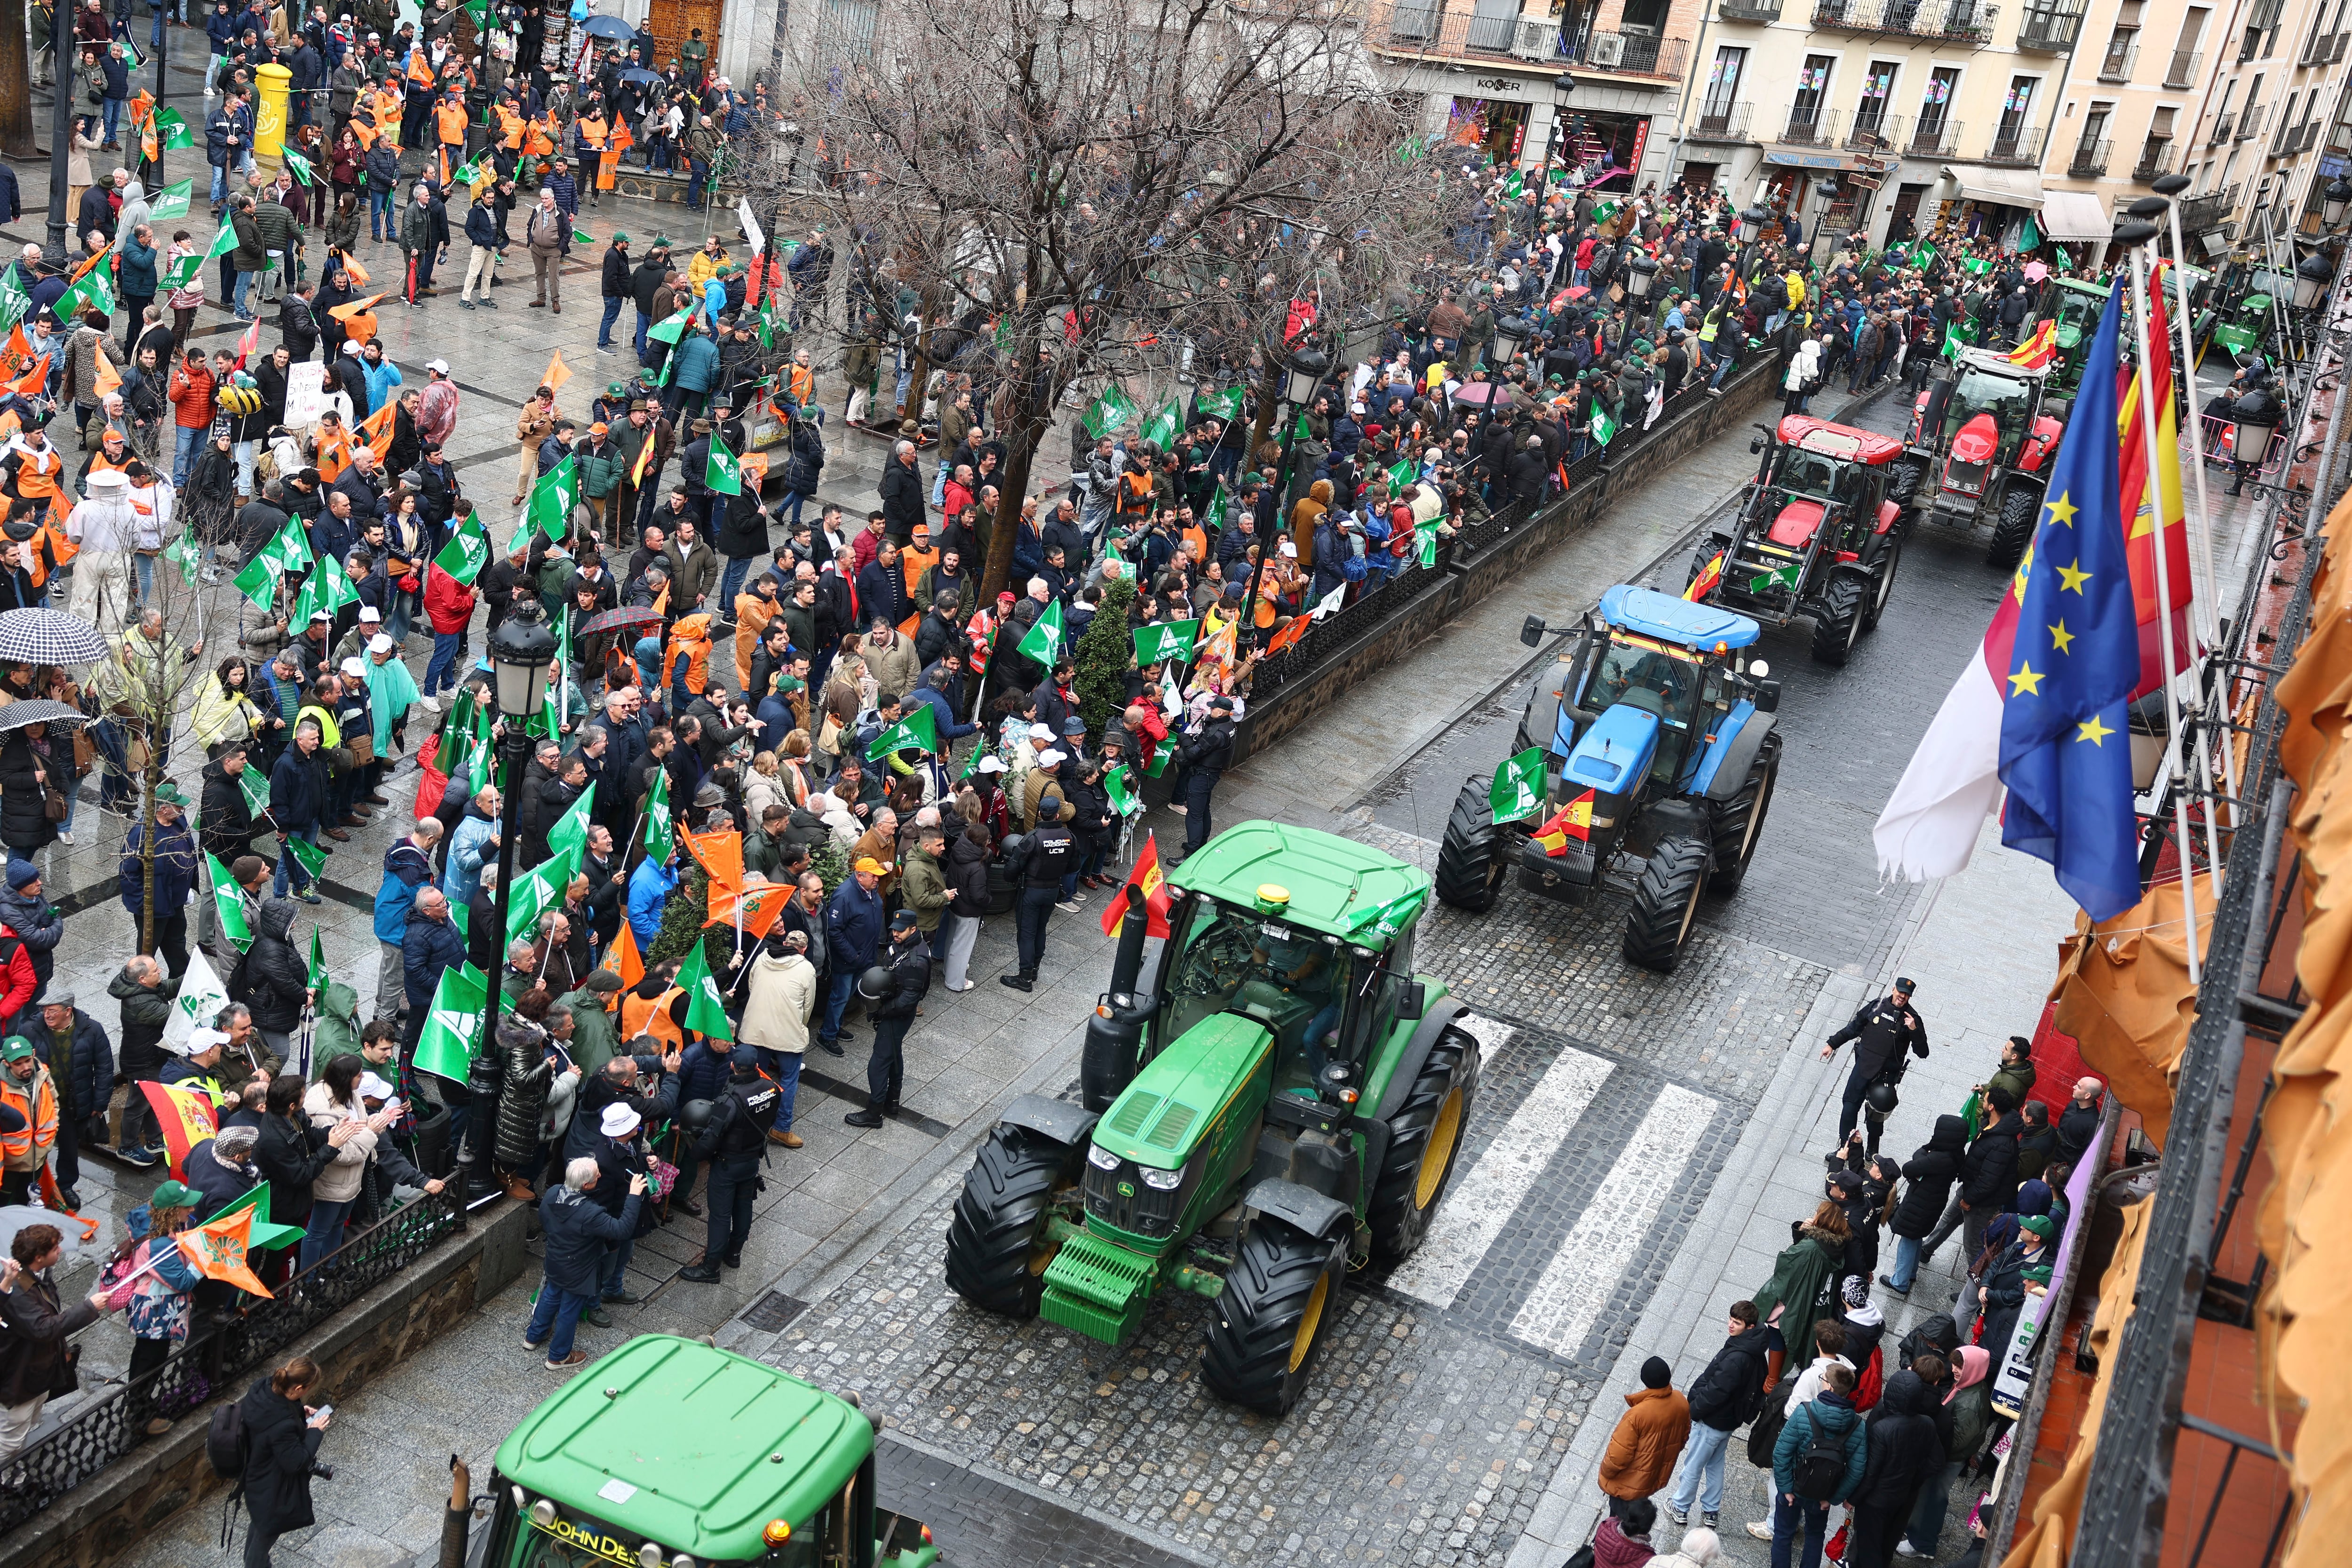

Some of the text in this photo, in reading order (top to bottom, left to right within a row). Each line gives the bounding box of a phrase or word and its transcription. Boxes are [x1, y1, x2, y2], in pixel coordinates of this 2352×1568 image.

[1478, 79, 1520, 91] KOKER
[1630, 123, 1645, 171] REBAJAS
[7, 353, 21, 371] UPA
[885, 734, 920, 750] ASAJA
[1499, 811, 1522, 821] ASAJA
[661, 821, 672, 846] ASA
[474, 1005, 486, 1043] TOLED
[747, 1090, 771, 1102] POLICIA
[749, 1092, 776, 1107] NACIONAL
[546, 1515, 599, 1550] JOHN
